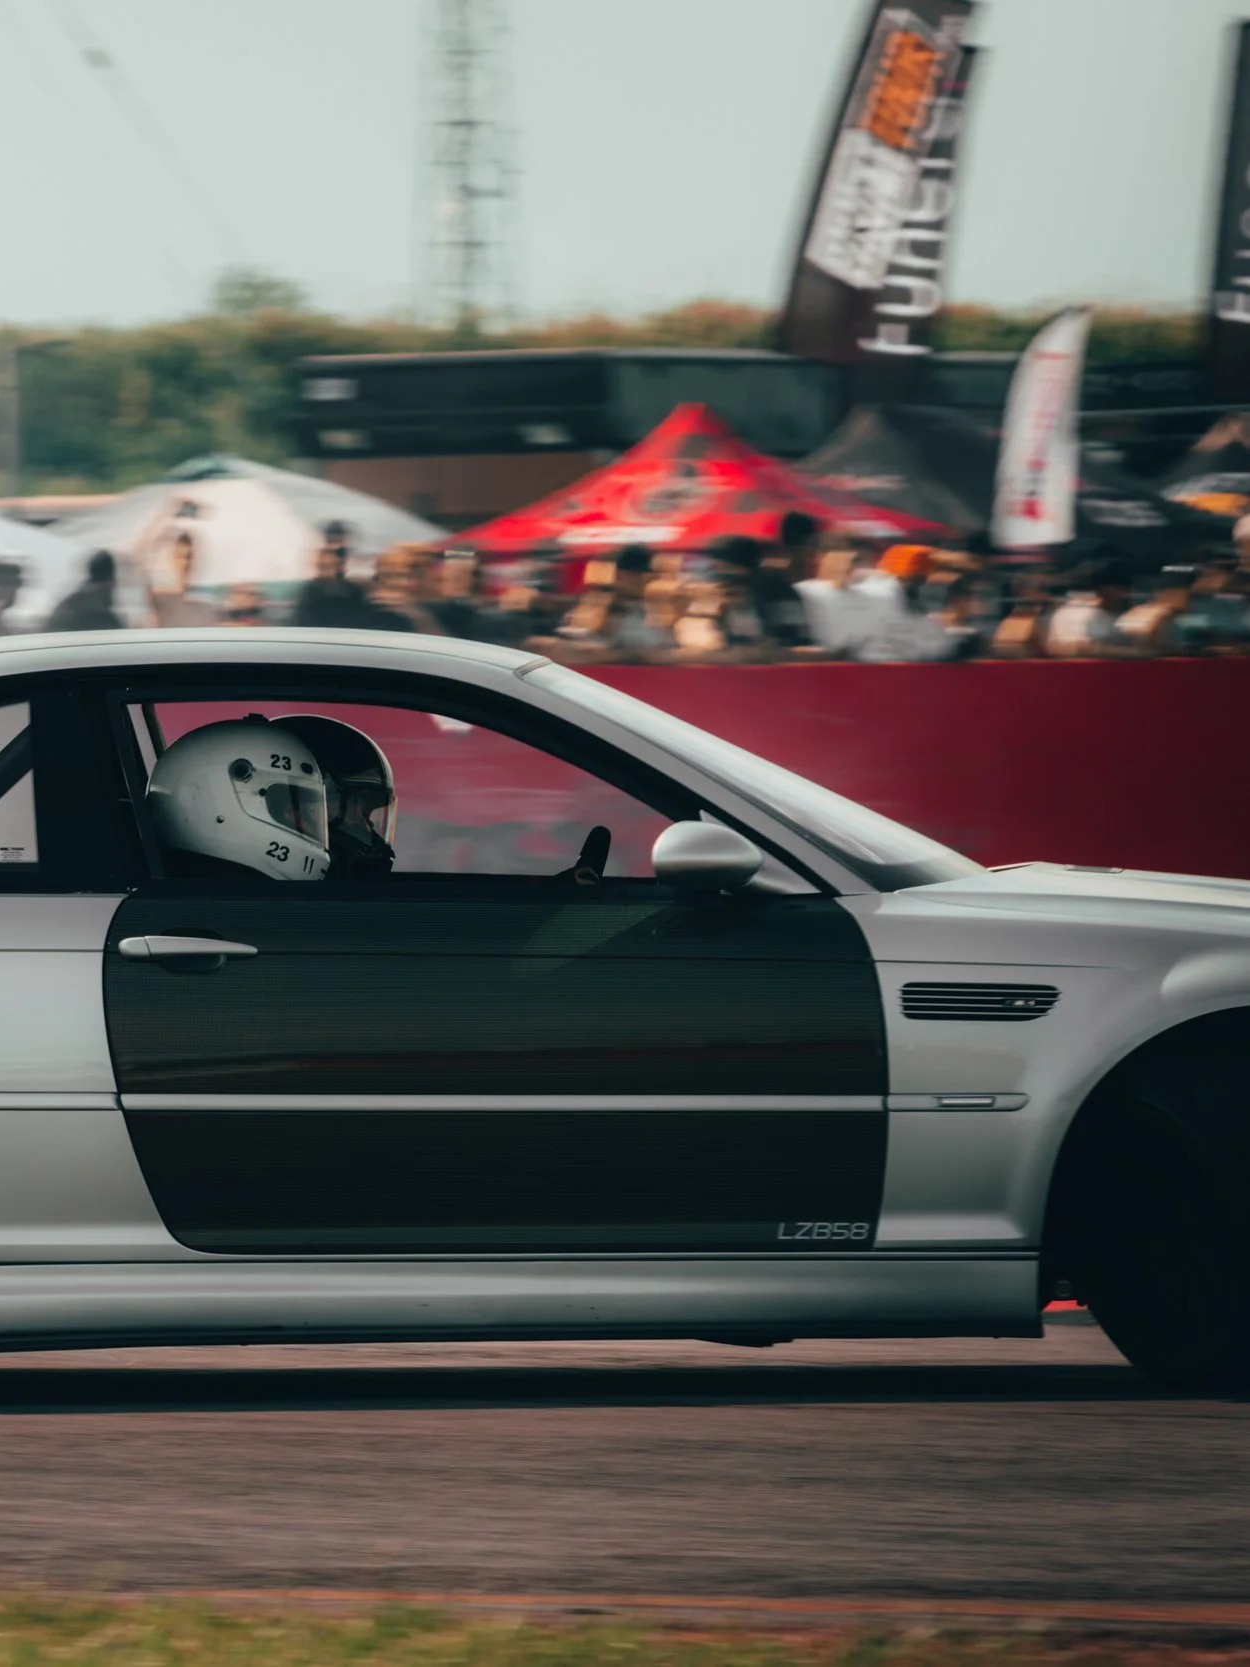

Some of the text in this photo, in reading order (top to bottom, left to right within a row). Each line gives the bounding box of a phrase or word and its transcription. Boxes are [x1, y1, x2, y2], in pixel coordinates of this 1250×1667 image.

[270, 754, 292, 771] 23
[265, 841, 290, 862] 23
[777, 1222, 870, 1240] LZB58
